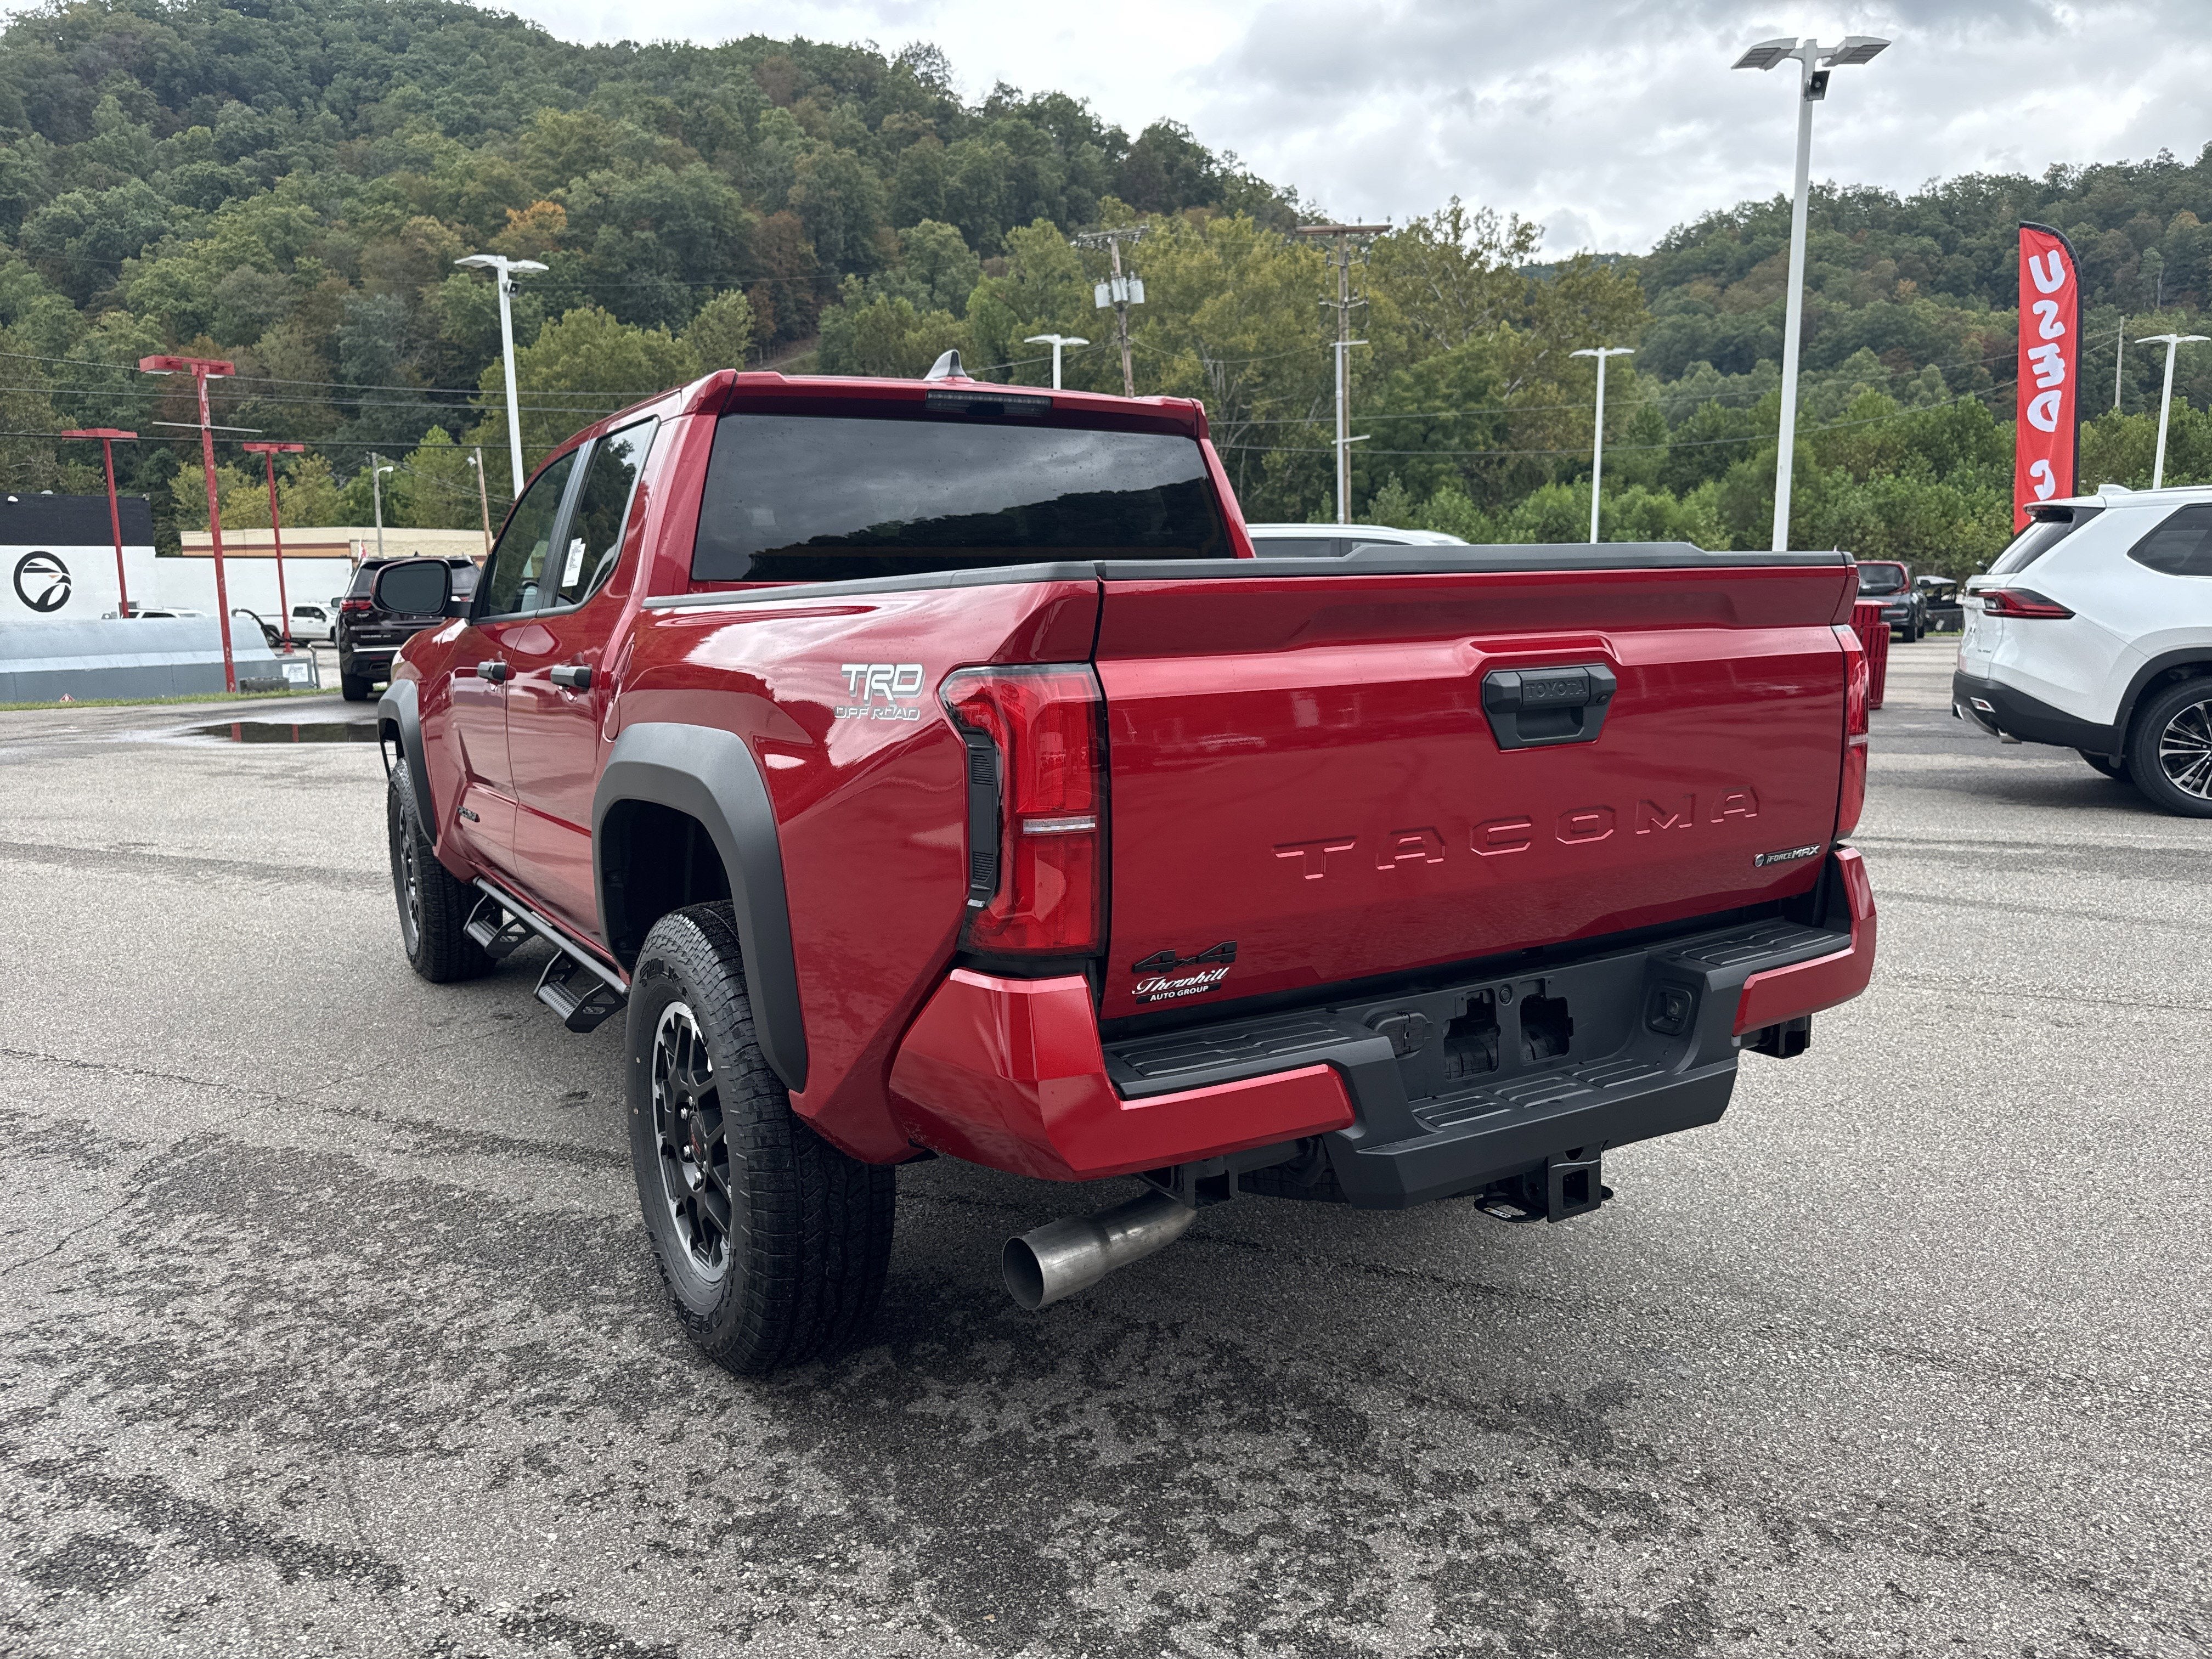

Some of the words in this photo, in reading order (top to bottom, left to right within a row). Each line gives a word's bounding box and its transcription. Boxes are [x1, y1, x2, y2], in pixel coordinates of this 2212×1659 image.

[840, 663, 926, 707] TRD
[1525, 680, 1587, 698] TOYOTA
[834, 706, 869, 719] OFF
[871, 706, 921, 721] ROAD
[1271, 785, 1760, 880] TACOMA
[1131, 967, 1231, 995] Thornhill
[1149, 990, 1176, 1002] AUTO
[1177, 985, 1209, 997] GROUP
